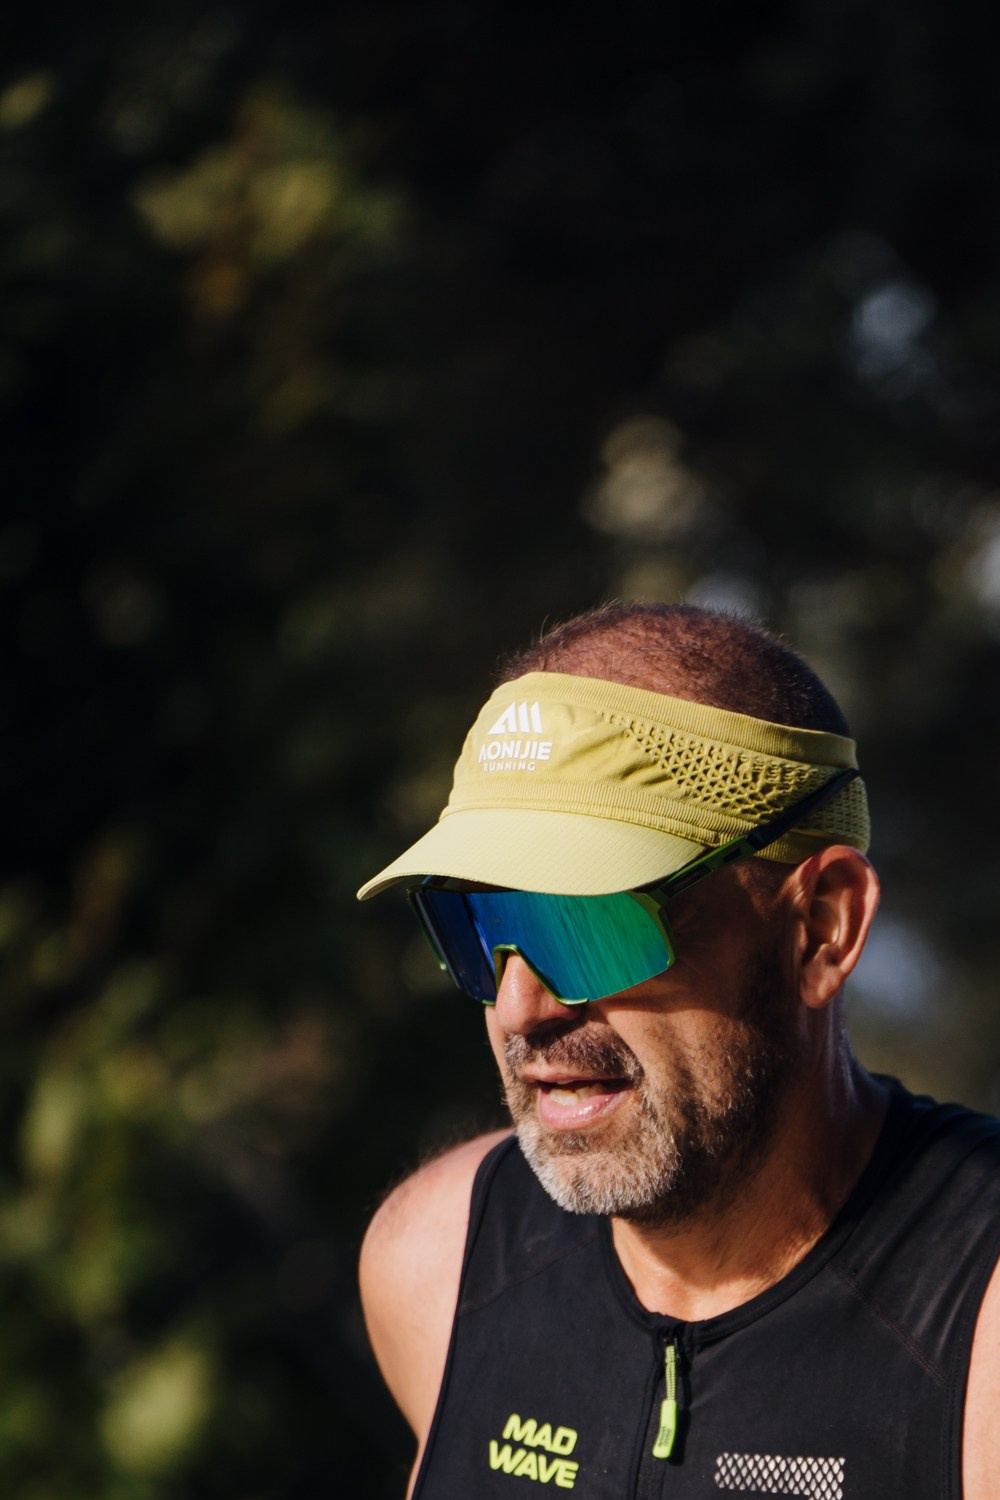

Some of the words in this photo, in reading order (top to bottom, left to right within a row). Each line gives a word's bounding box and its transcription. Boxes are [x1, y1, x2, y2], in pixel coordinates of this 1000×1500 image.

[478, 740, 553, 763] AONIJIE
[483, 761, 536, 772] RUNNING
[502, 1413, 578, 1456] MAD
[489, 1439, 579, 1489] WAVE
